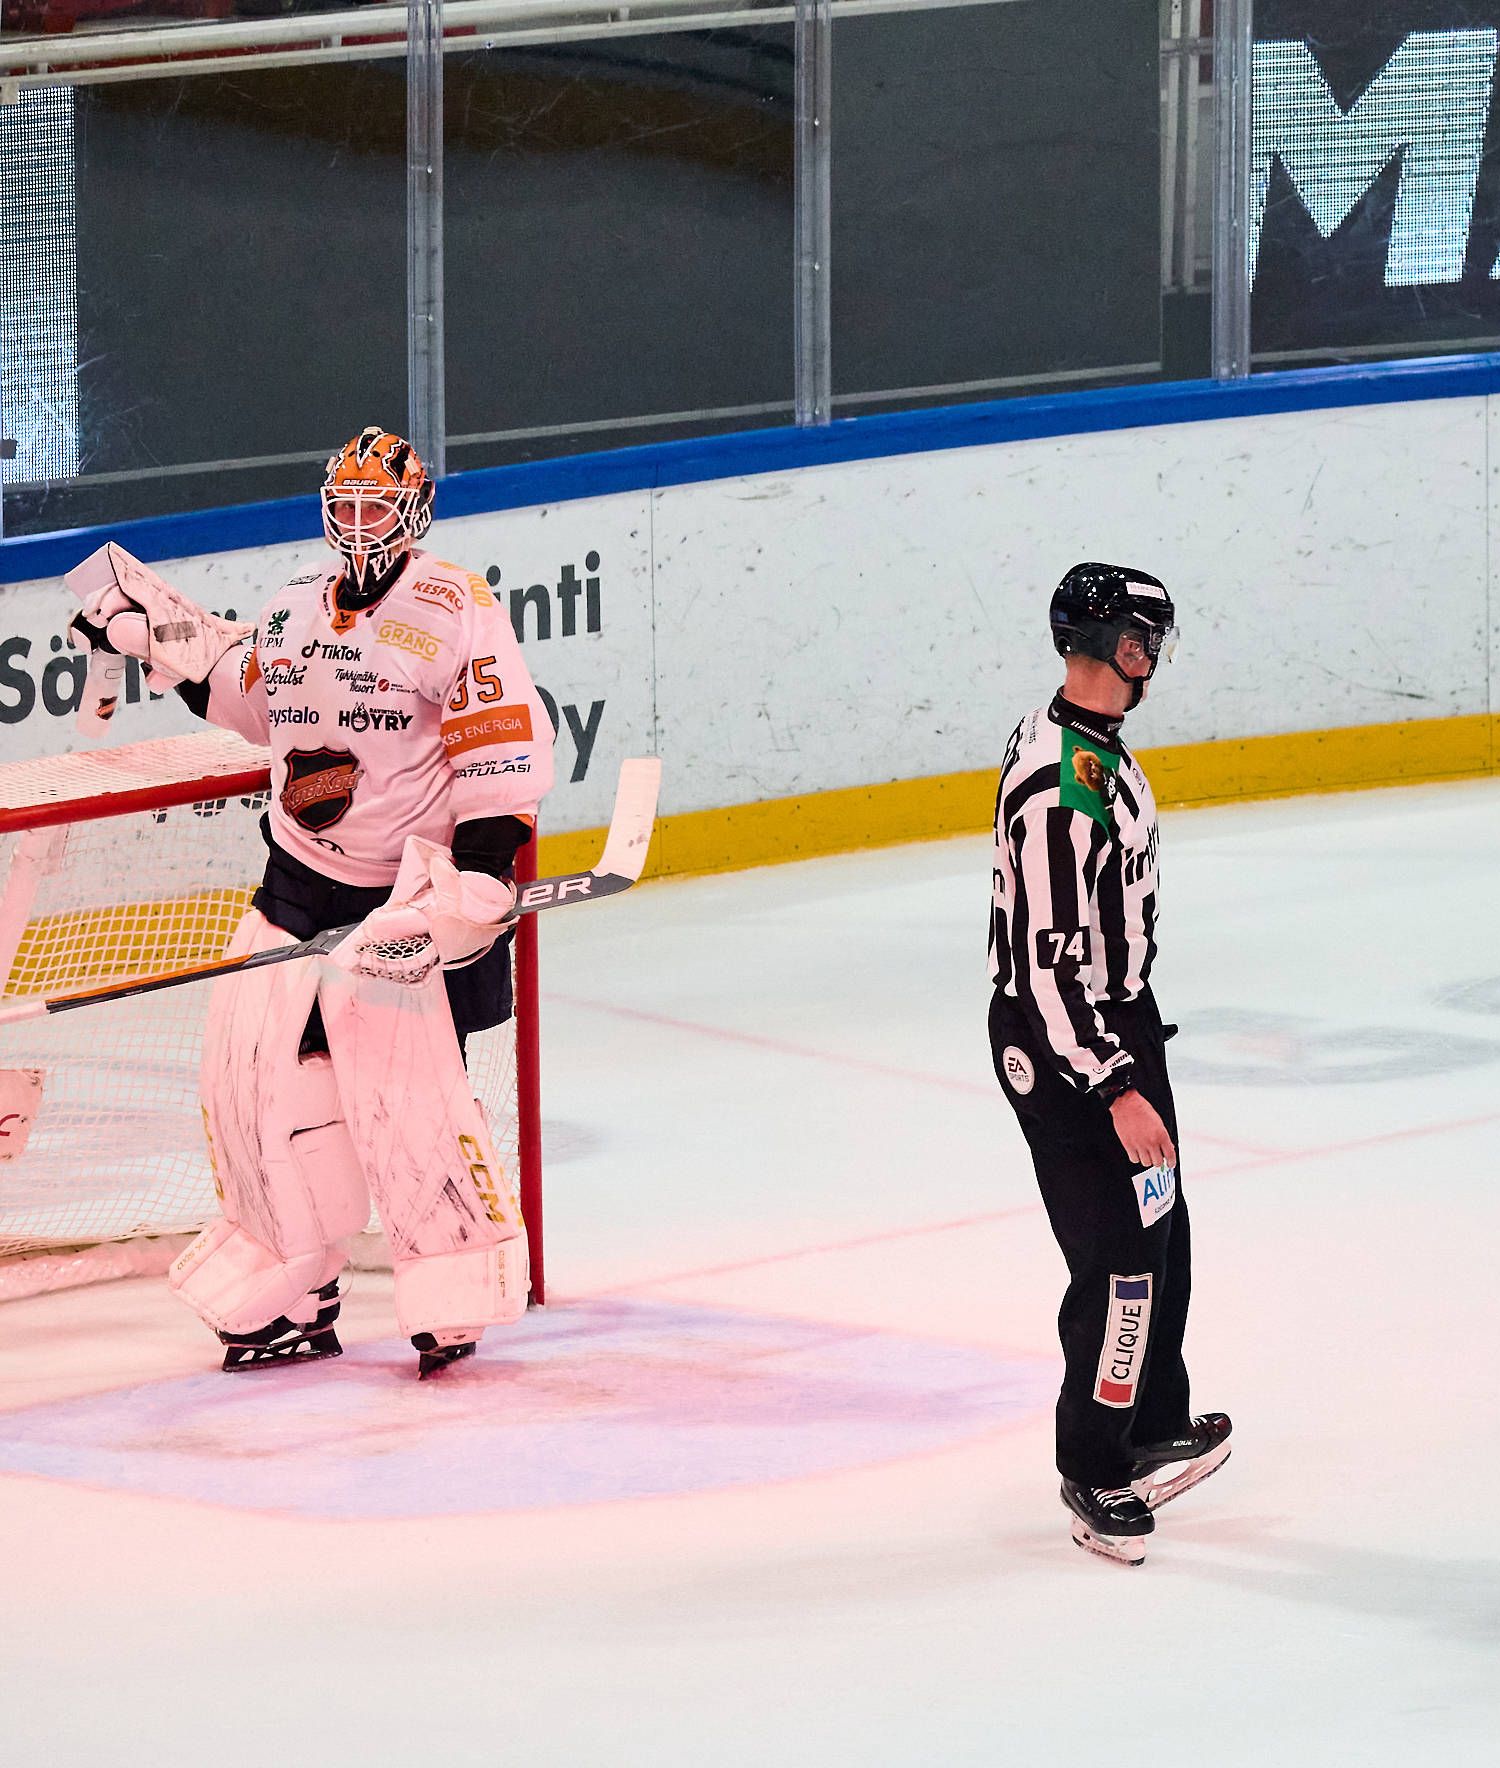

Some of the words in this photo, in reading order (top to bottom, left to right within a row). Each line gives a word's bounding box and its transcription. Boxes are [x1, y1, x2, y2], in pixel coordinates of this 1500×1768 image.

[412, 581, 463, 610] KESPRO
[321, 644, 362, 661] TikTok
[379, 624, 438, 657] GRANO
[449, 656, 503, 711] 35
[464, 718, 523, 738] ENERGIA
[1048, 931, 1085, 965] 74
[1008, 1056, 1028, 1074] EA
[1009, 1073, 1030, 1083] SPORTS
[458, 1134, 506, 1224] CCM
[1111, 1305, 1142, 1380] CLIQUE
